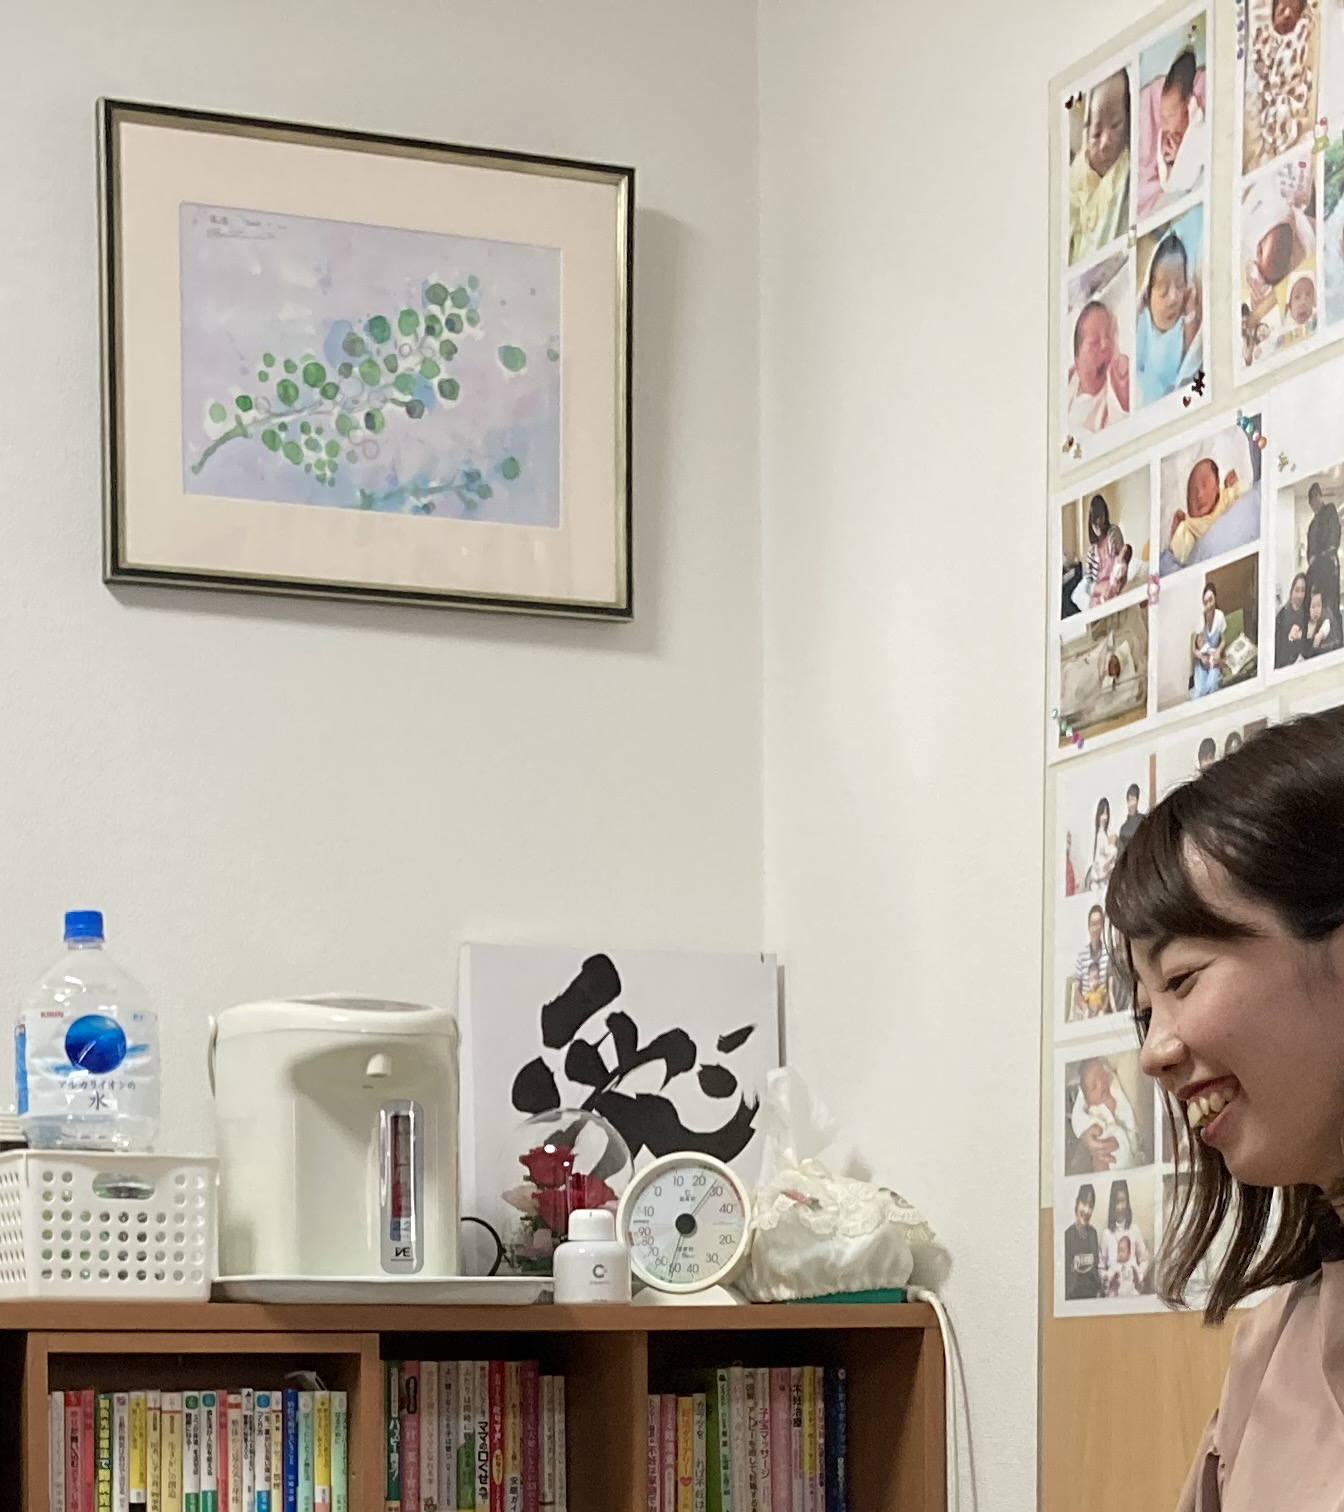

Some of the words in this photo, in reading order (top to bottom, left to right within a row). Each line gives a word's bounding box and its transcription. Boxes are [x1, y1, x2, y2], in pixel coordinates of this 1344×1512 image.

[58, 1080, 136, 1090] アルカリイオンの
[89, 1092, 108, 1110] 水
[673, 1175, 684, 1186] 10
[692, 1175, 706, 1186] 20
[654, 1187, 662, 1197] 0
[709, 1186, 723, 1197] 30
[719, 1203, 733, 1214] 40
[638, 1227, 651, 1236] 90
[719, 1234, 731, 1244] 20
[648, 1247, 659, 1256] 70
[706, 1254, 718, 1263] 30
[686, 1264, 699, 1273] 40
